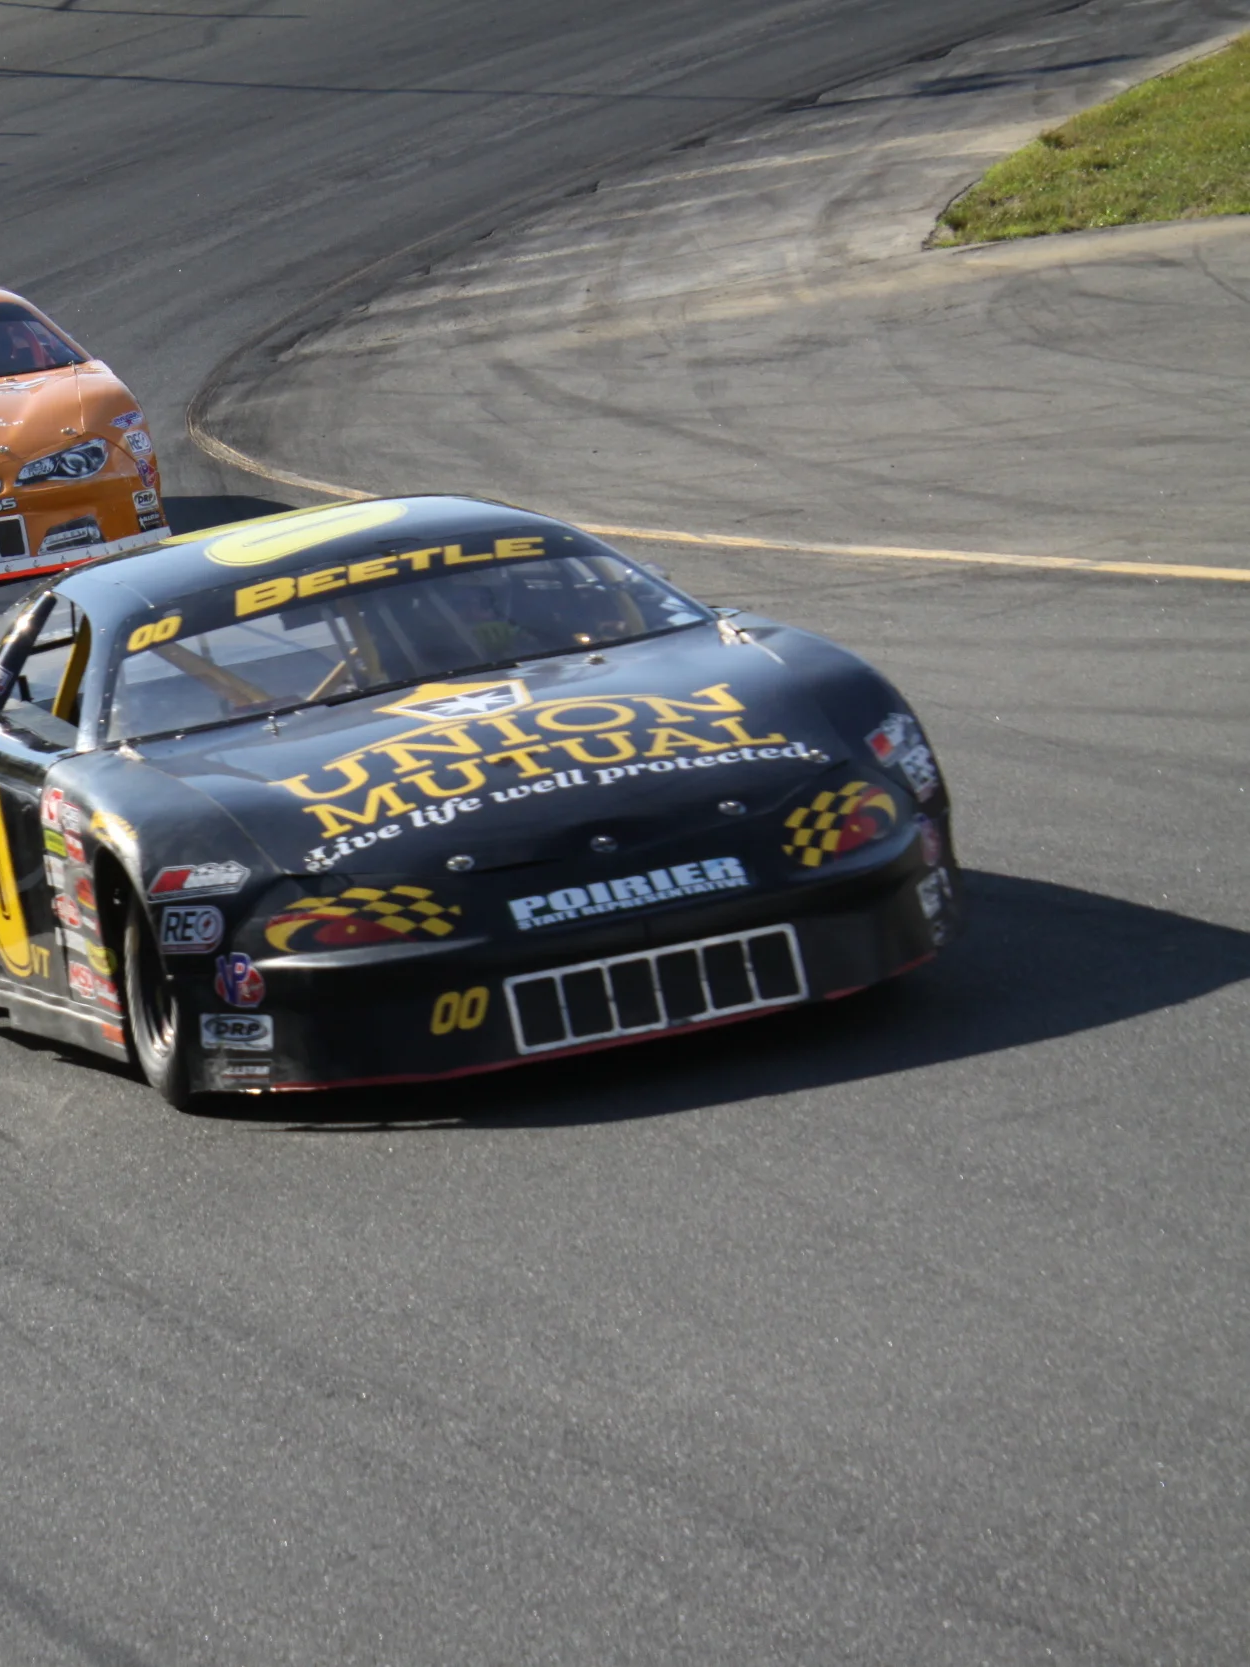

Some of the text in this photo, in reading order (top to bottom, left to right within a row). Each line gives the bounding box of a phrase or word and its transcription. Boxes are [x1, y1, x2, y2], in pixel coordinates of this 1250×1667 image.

[235, 536, 546, 617] BEETLE
[127, 616, 183, 652] 00
[270, 683, 747, 799] UNION
[302, 716, 788, 840] MUTUAL
[305, 821, 404, 872] Live
[409, 796, 483, 829] life
[490, 768, 590, 803] well
[507, 857, 748, 921] POIRIER
[517, 875, 751, 932] STATE REPRESENTATIVE
[29, 942, 50, 979] VT
[213, 1021, 261, 1036] DRP
[430, 986, 490, 1036] 00
